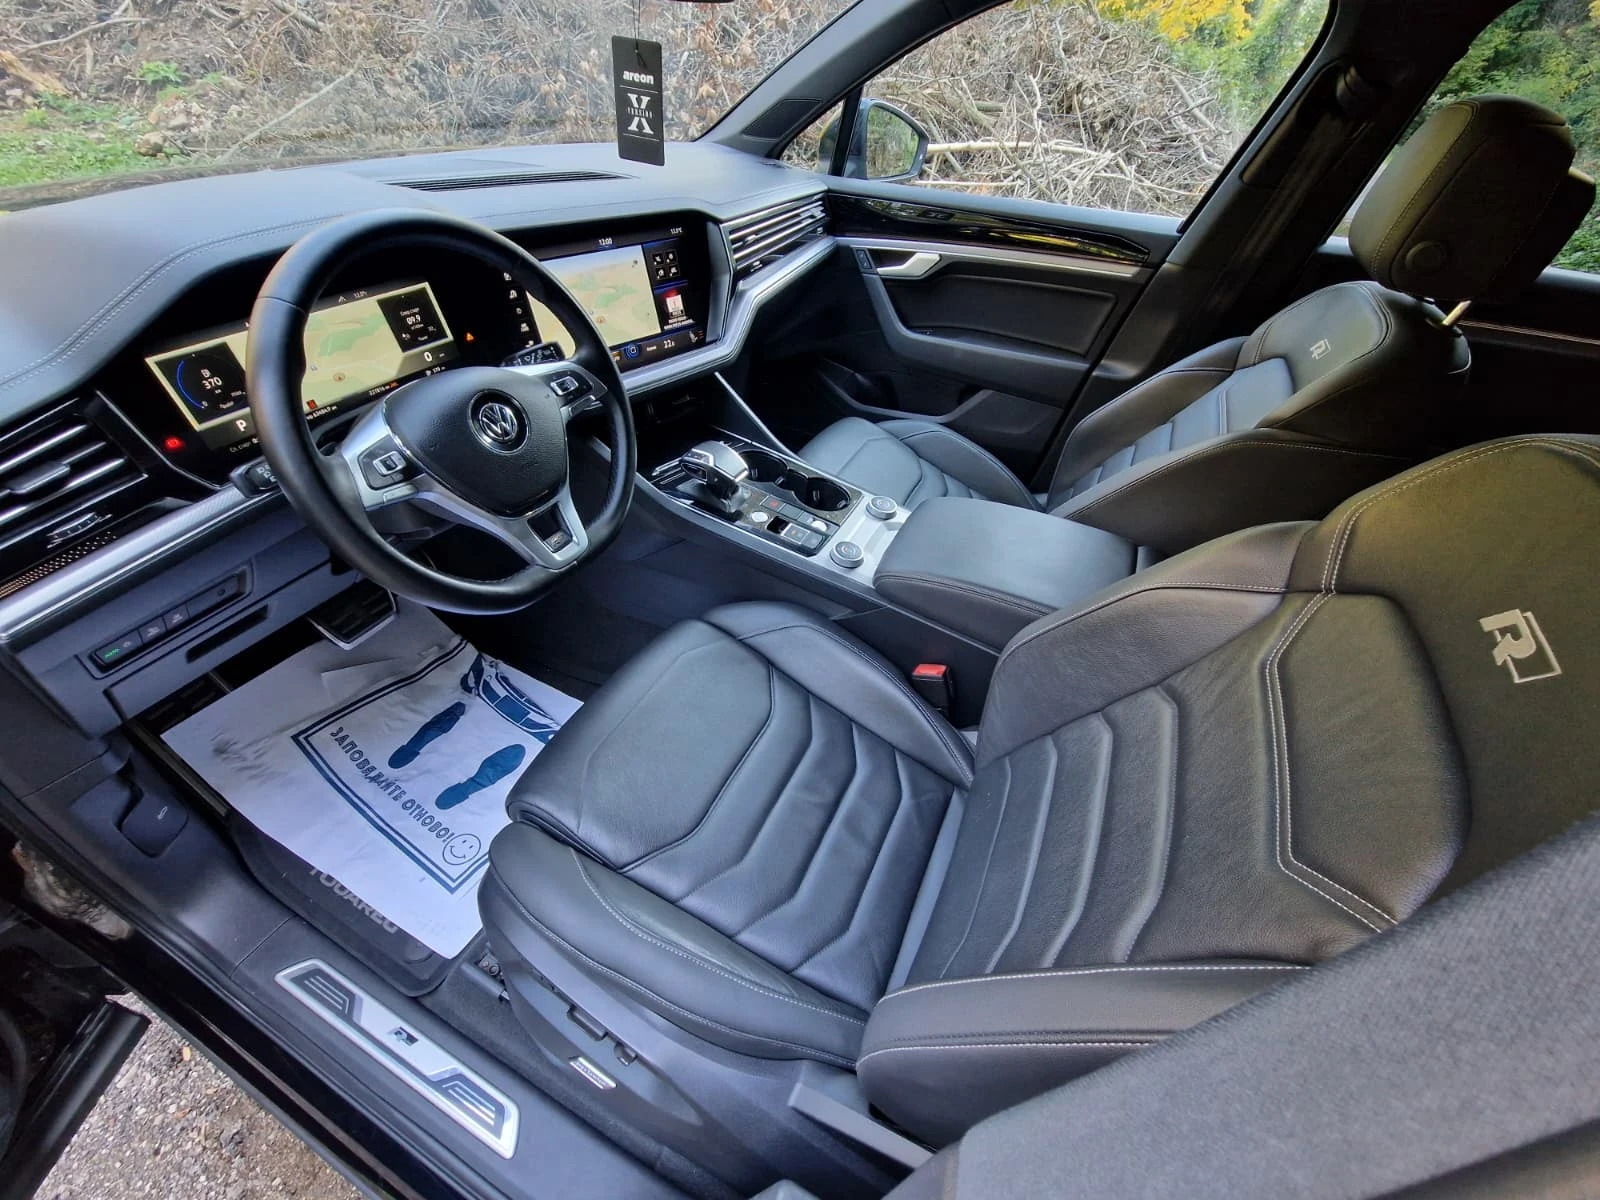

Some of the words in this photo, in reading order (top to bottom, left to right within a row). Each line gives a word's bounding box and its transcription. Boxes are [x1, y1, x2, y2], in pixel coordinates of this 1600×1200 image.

[623, 71, 654, 84] areon
[423, 351, 433, 362] 0
[202, 376, 222, 389] 370
[235, 419, 247, 432] P
[1479, 608, 1557, 680] R
[329, 726, 408, 802] ЗАПОВЯДАЙТЕ
[401, 798, 455, 843] ОТНОВО!
